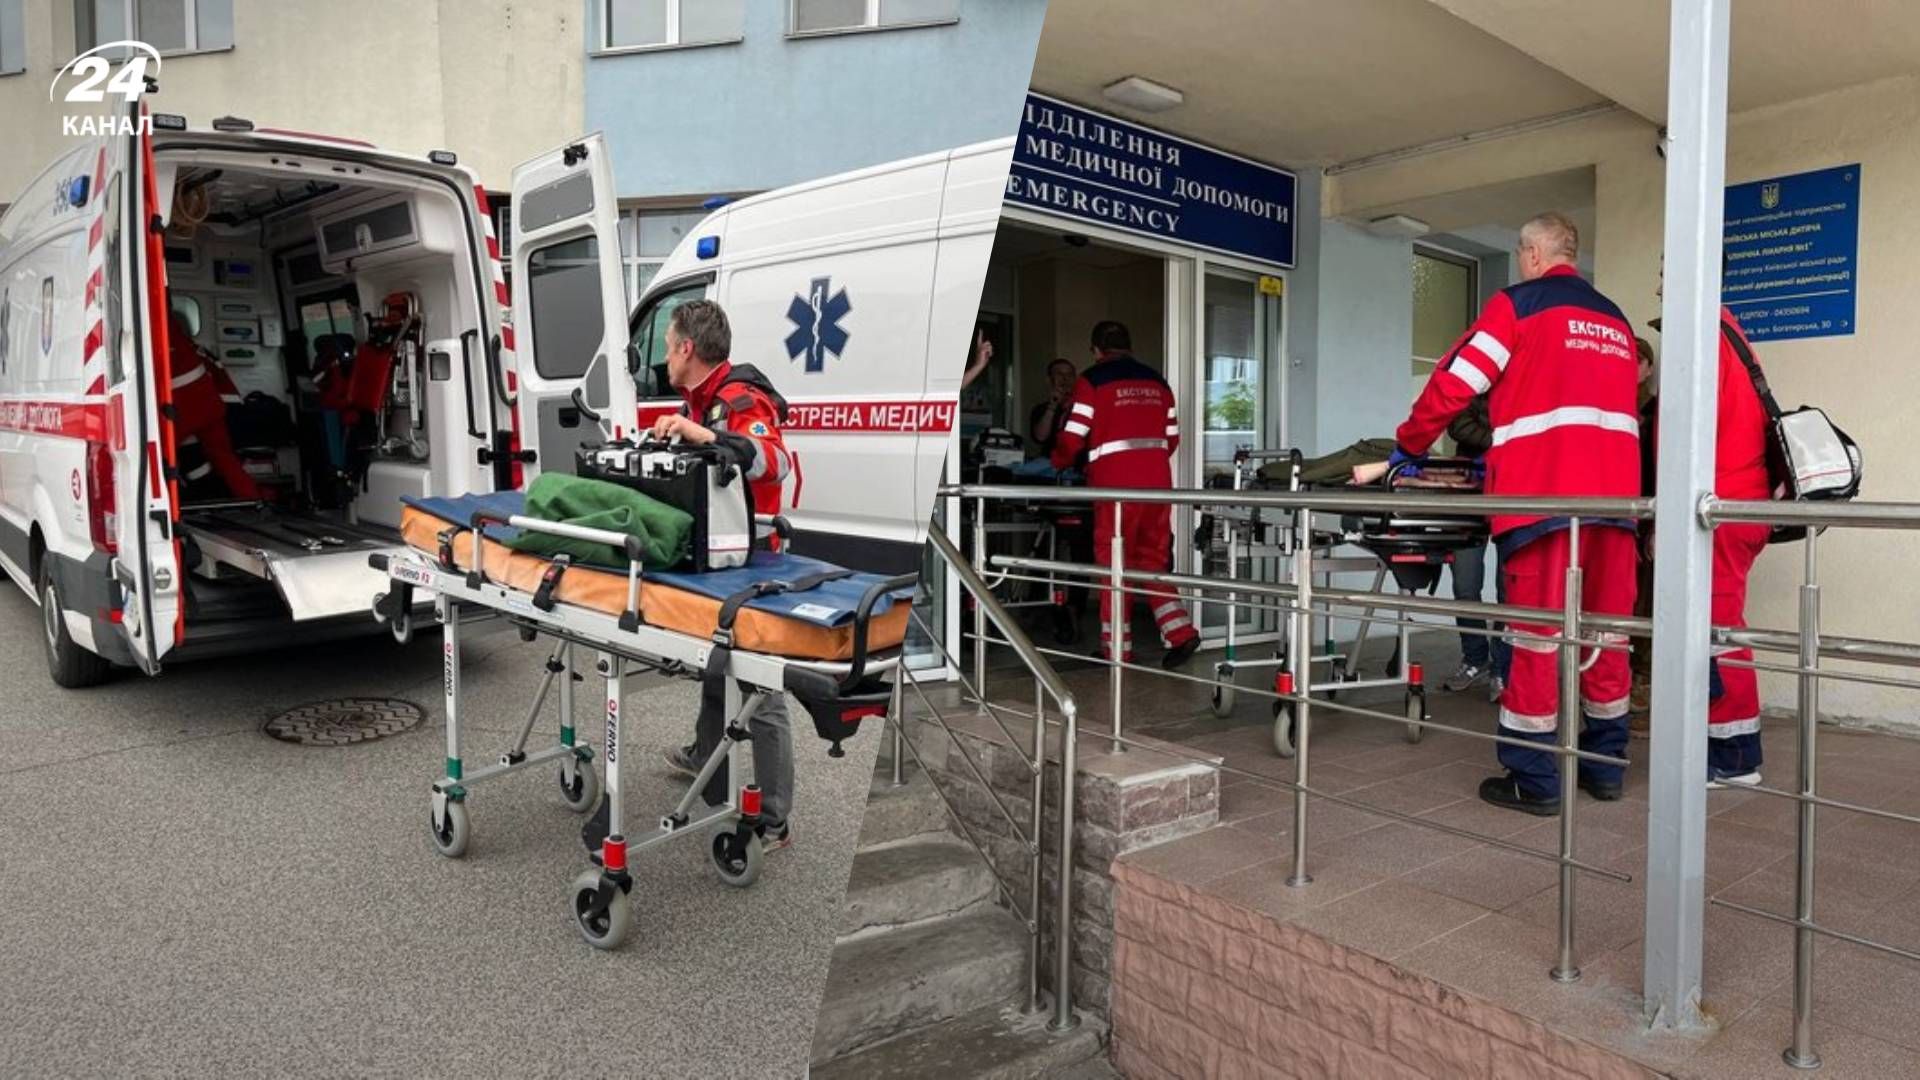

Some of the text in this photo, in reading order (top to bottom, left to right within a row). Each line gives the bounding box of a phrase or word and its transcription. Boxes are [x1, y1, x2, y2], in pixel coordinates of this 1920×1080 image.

[1025, 103, 1181, 166] ІДДІЛЕННЯ
[1005, 172, 1181, 233] EMERGENCY
[1025, 134, 1289, 225] МЕДИЧНОЇ ДОПОМОГИ
[1568, 319, 1629, 346] ЕКСТРЕНА
[776, 405, 951, 431] СТРЕНА МЕДИЧ
[607, 711, 616, 762] FERNO
